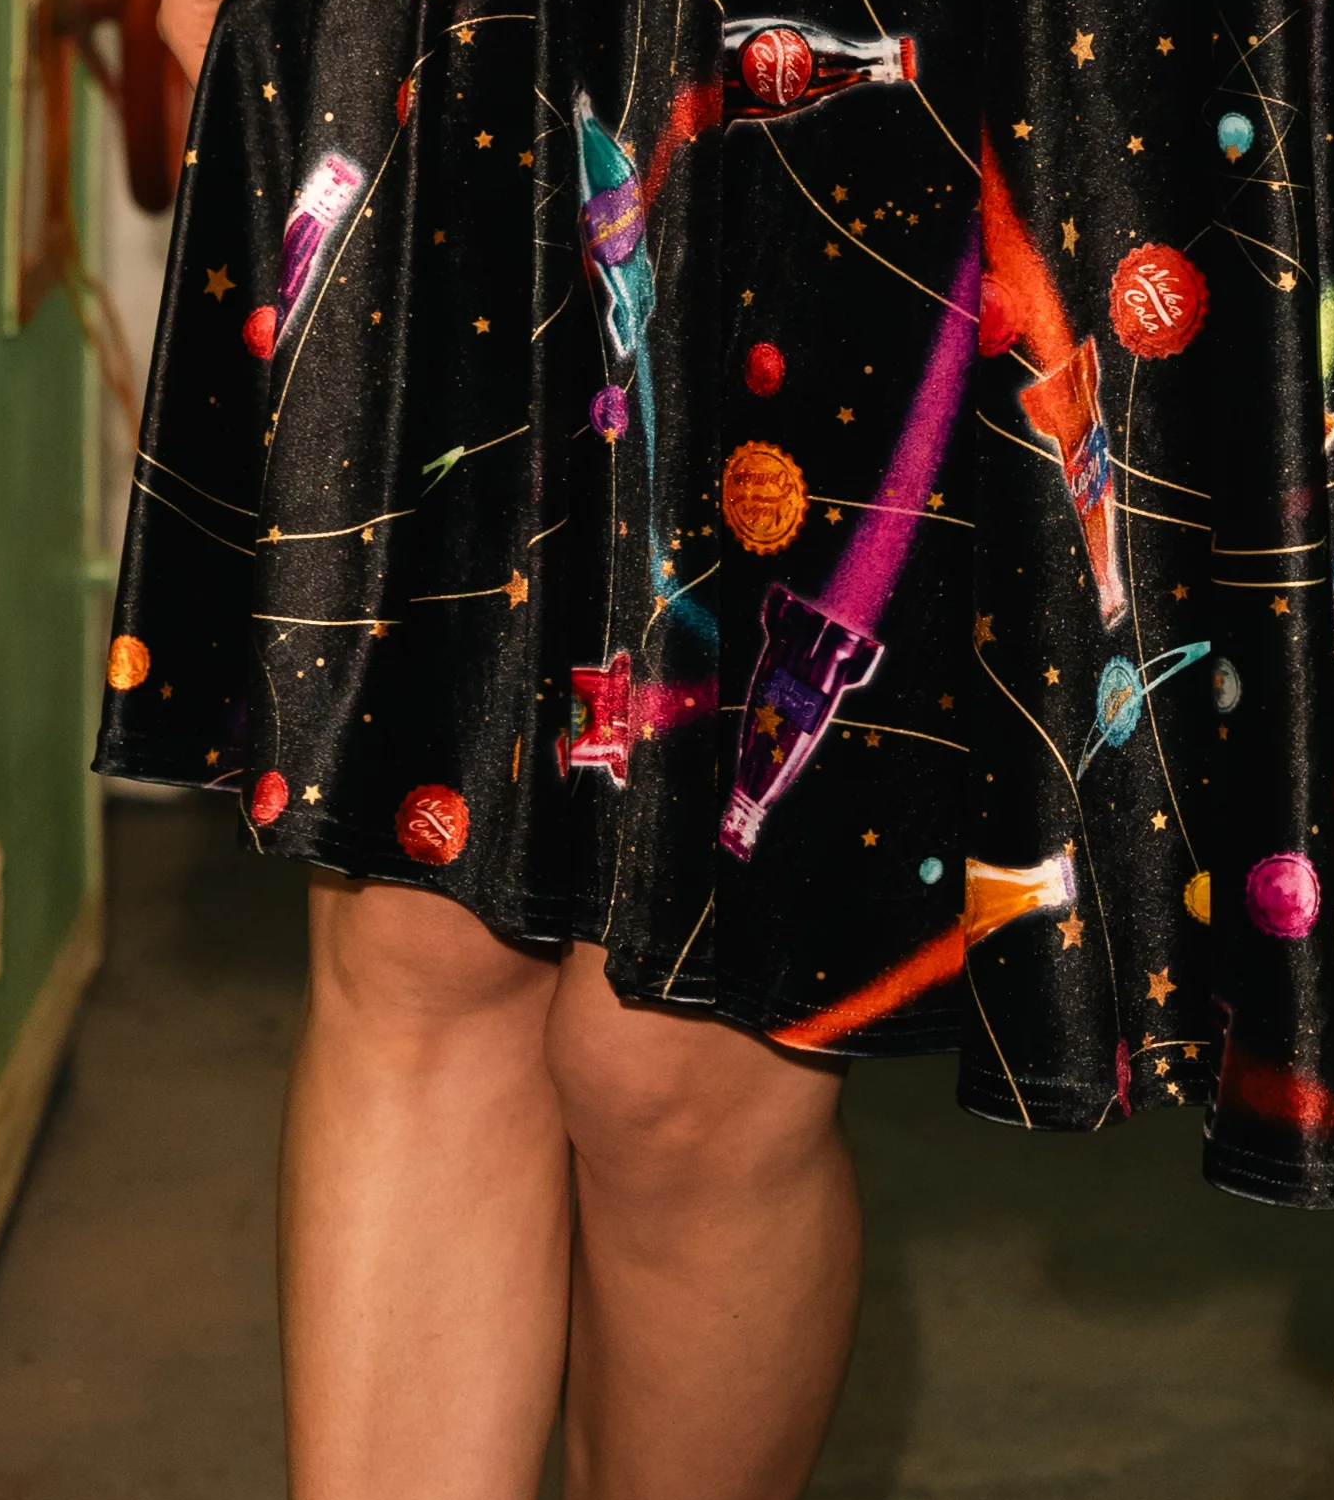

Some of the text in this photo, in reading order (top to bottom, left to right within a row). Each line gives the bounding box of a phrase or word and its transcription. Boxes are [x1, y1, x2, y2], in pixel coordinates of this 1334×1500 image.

[752, 42, 775, 93] Cola
[1124, 289, 1160, 334] Cola
[1137, 263, 1184, 320] Nuka
[408, 819, 444, 848] Cola
[415, 798, 456, 835] Nuka
